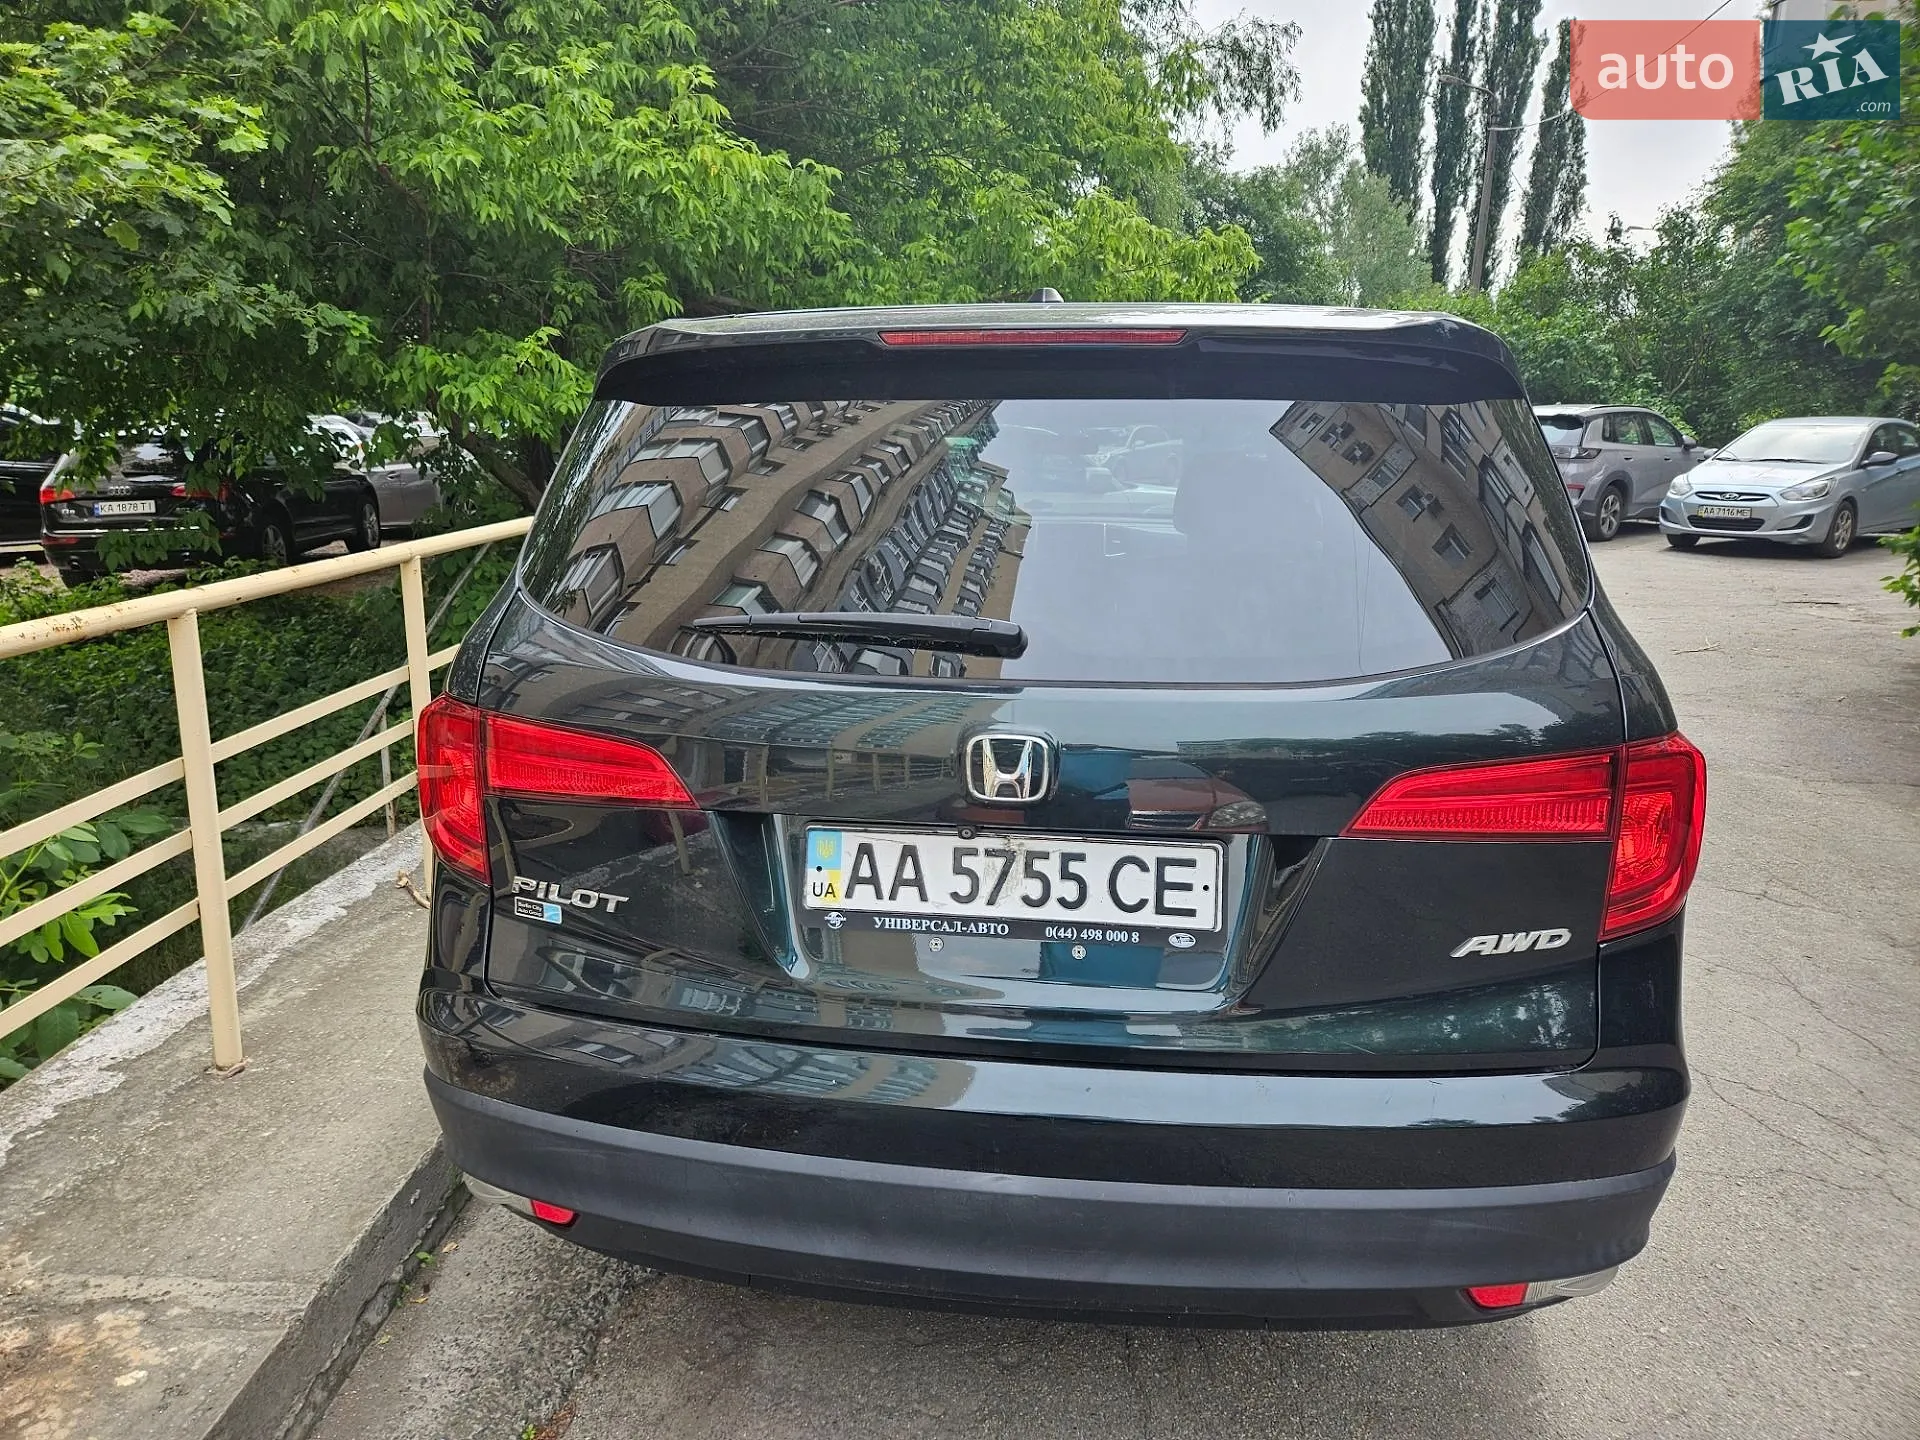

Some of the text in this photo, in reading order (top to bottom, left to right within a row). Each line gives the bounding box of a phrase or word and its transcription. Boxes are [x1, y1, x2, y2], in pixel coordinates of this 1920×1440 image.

[100, 504, 114, 513] KA
[116, 502, 138, 512] 1878
[812, 881, 837, 898] UA
[844, 842, 1197, 918] AA 5755 CE
[511, 875, 630, 913] PILOT
[873, 916, 1010, 936] УНІВЕРСАЛ-АВТО
[1045, 926, 1140, 943] 0(44) 498 000 8
[1449, 927, 1572, 958] AWD
